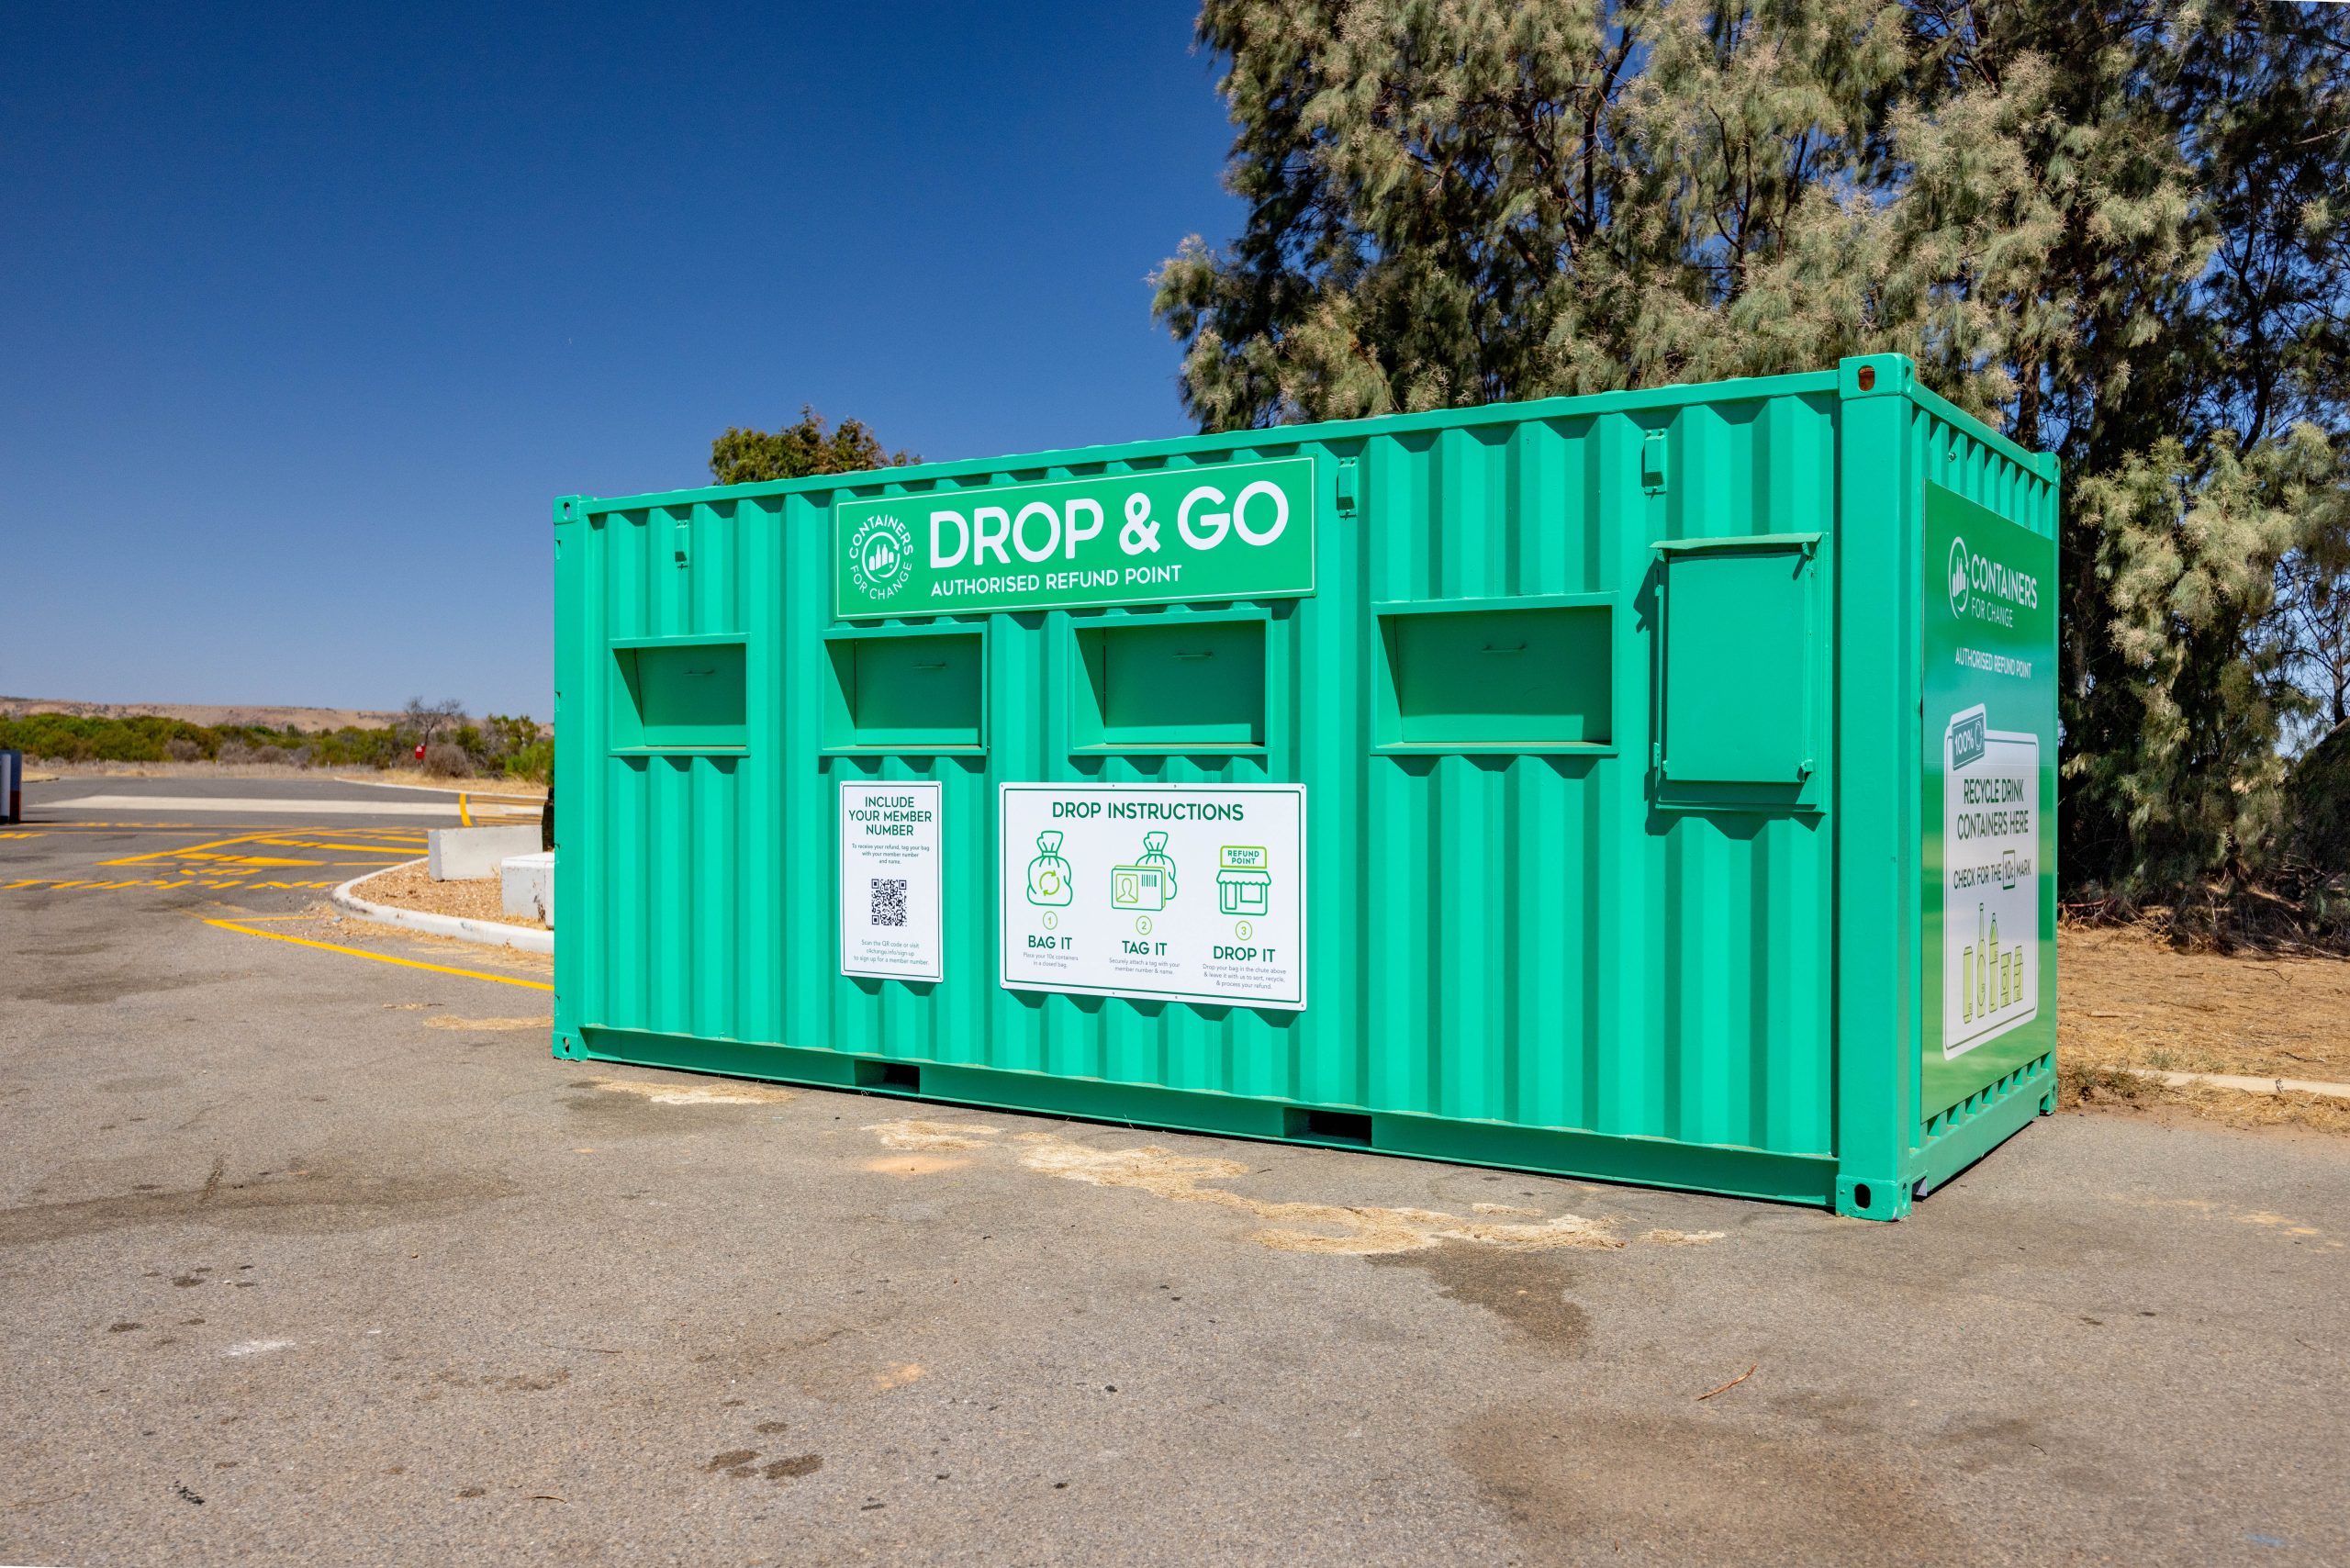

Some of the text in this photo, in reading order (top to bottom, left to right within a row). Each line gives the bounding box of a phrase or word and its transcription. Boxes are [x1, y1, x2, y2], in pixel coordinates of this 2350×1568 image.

[849, 514, 913, 559] CONTAINERS
[930, 480, 1289, 569] DROP & GO
[850, 562, 912, 600] FOR CHANGE
[931, 565, 1182, 597] AUTHORISED REFUND POINT
[1972, 554, 2037, 610] CONTAINERS
[1972, 598, 2013, 628] FOR CHANGE
[1955, 647, 2032, 678] AUTHORISED REFUND POINT
[1955, 728, 1974, 756] 100%
[865, 797, 914, 807] INCLUDE
[1964, 778, 2024, 804] RECYCLE DRINK
[849, 810, 932, 822] YOUR MEMBER
[1053, 802, 1244, 821] DROP INSTRUCTIONS
[867, 824, 913, 835] NUMBER
[1958, 811, 2028, 840] CONTAINERS HERE
[1953, 868, 1975, 890] CHECK
[1977, 866, 1989, 885] FOR
[1991, 864, 2001, 881] THE
[2017, 859, 2031, 878] MARK
[1142, 922, 1147, 930] 2
[1241, 926, 1247, 935] 3
[1028, 935, 1072, 950] BAG IT
[1122, 940, 1167, 956] TAG IT
[1214, 946, 1275, 962] DROP IT
